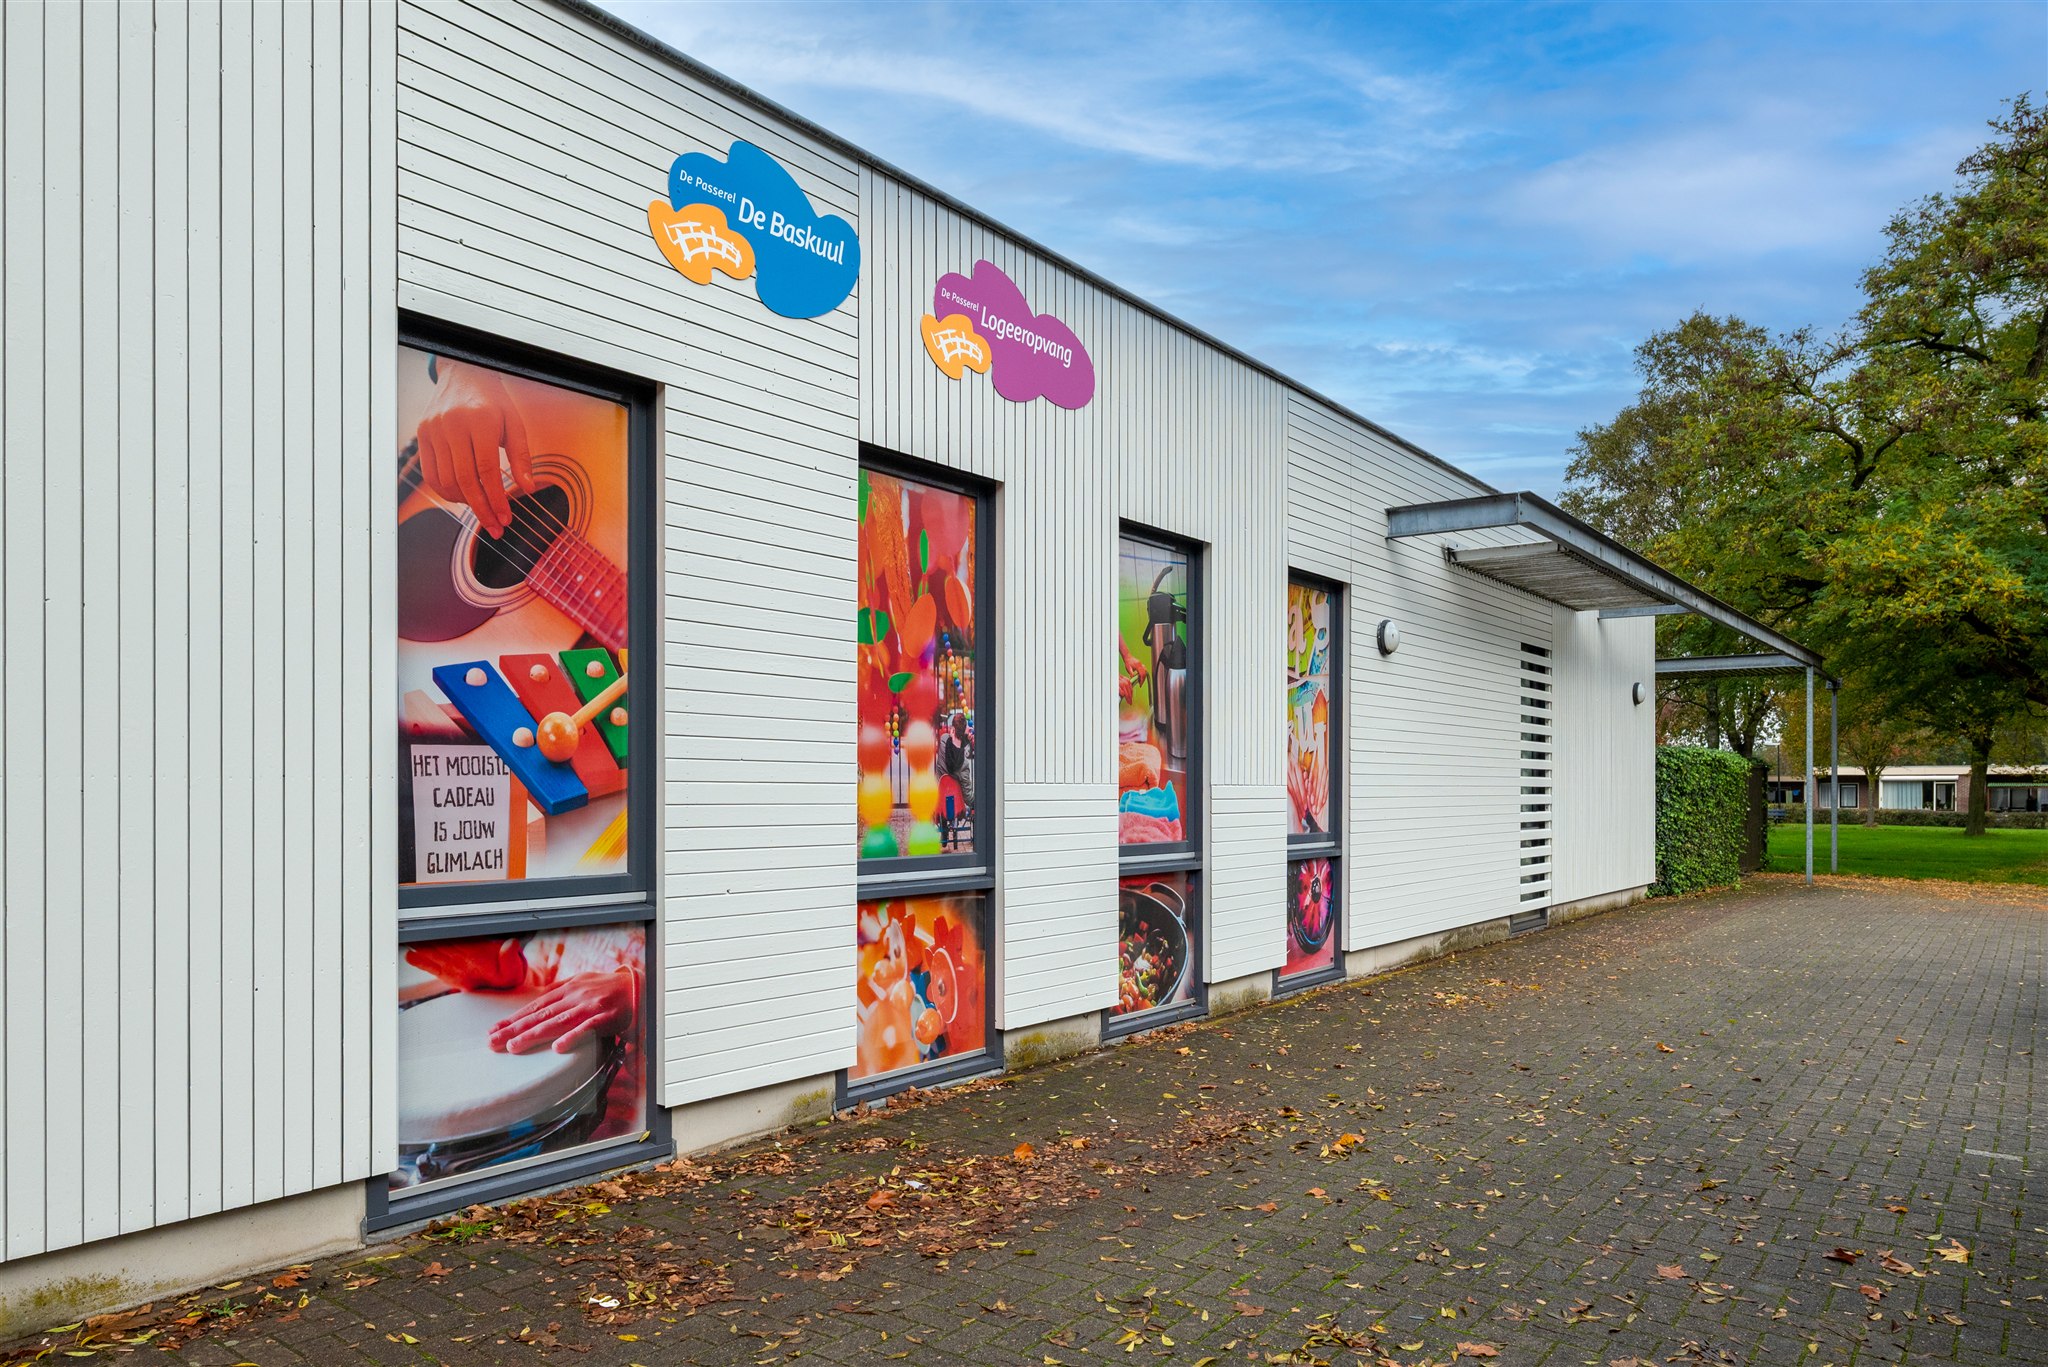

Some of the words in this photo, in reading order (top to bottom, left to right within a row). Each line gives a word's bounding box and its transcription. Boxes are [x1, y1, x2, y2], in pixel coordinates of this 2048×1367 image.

[680, 169, 692, 184] De
[695, 177, 736, 203] Passerel
[738, 197, 766, 230] De
[770, 211, 844, 265] Baskuul
[941, 288, 950, 299] De
[952, 292, 979, 312] Passerel
[981, 306, 1072, 368] Logeeropvang
[413, 754, 440, 776] HET
[433, 787, 495, 808] CADEAU
[434, 821, 447, 841] IS
[452, 820, 495, 841] JOUW
[427, 848, 503, 874] GLIMLACH
